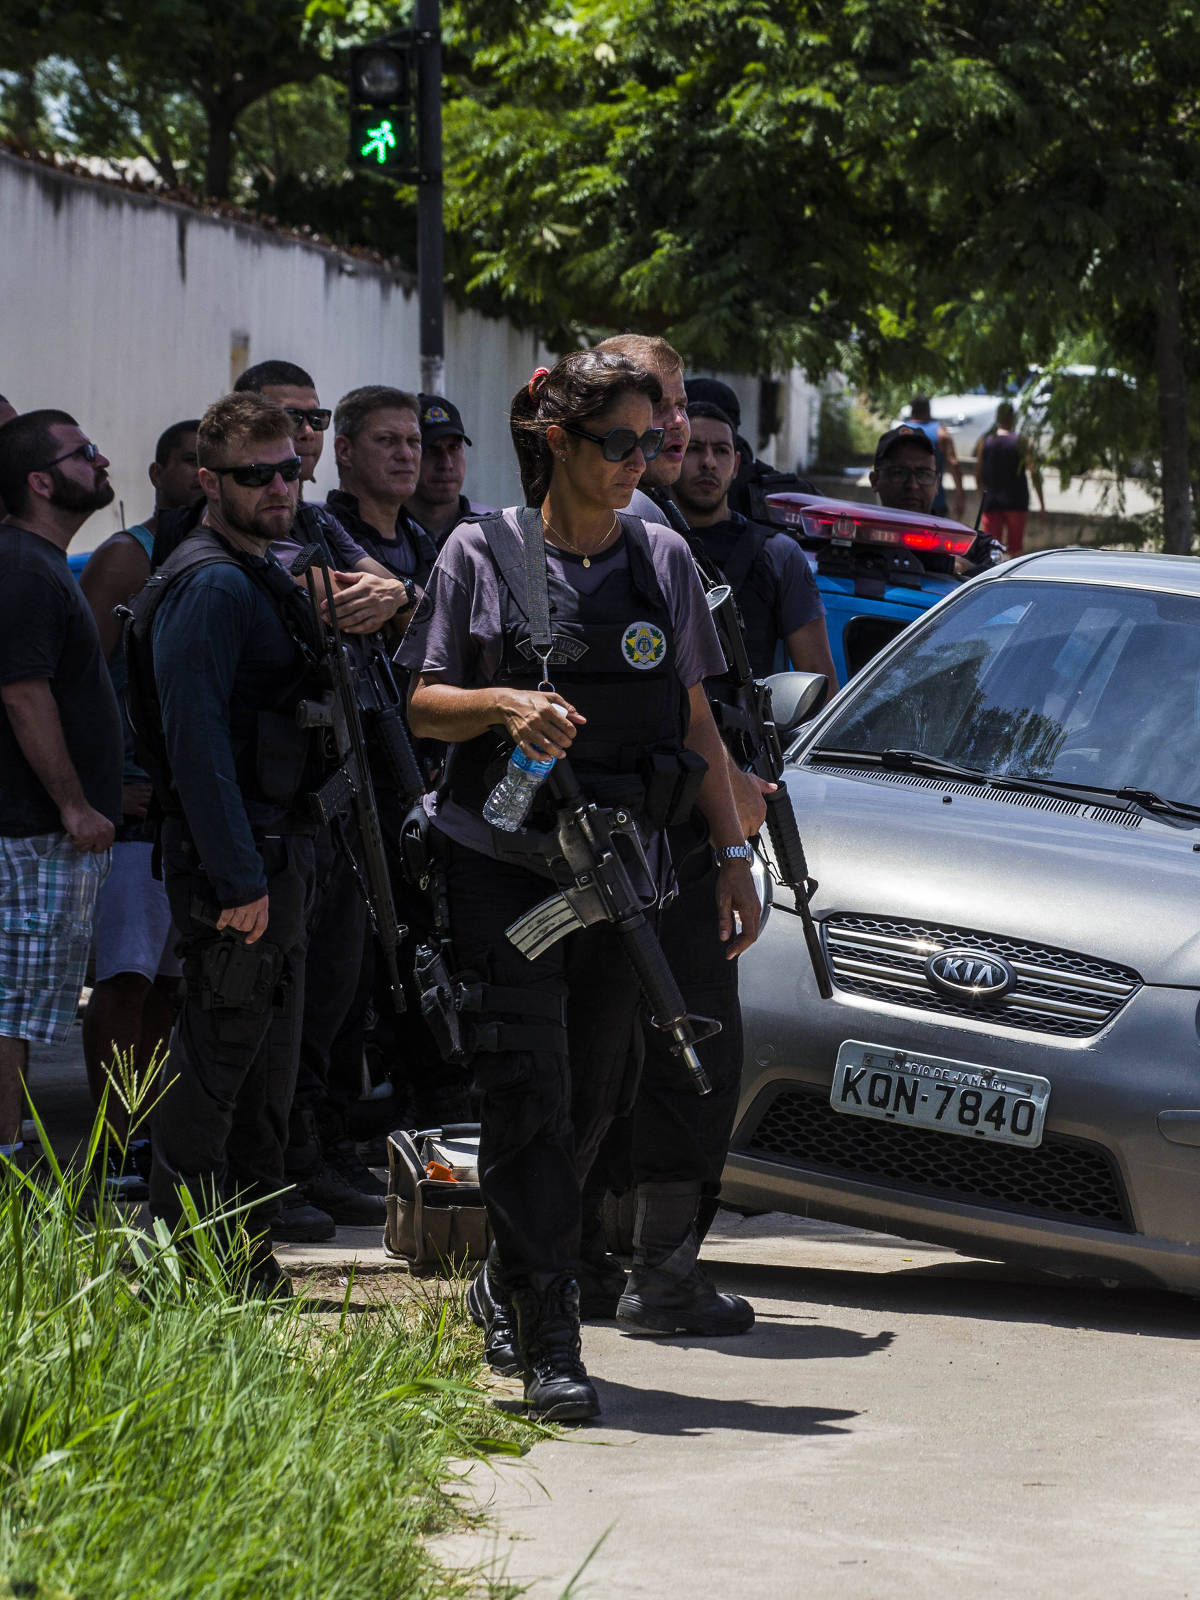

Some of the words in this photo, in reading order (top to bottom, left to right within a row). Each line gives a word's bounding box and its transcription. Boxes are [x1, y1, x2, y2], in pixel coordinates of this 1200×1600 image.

[942, 958, 994, 986] KIA
[933, 1067, 950, 1080] DE
[954, 1072, 1008, 1091] JANEIRO
[841, 1066, 1036, 1137] KQN-7840
